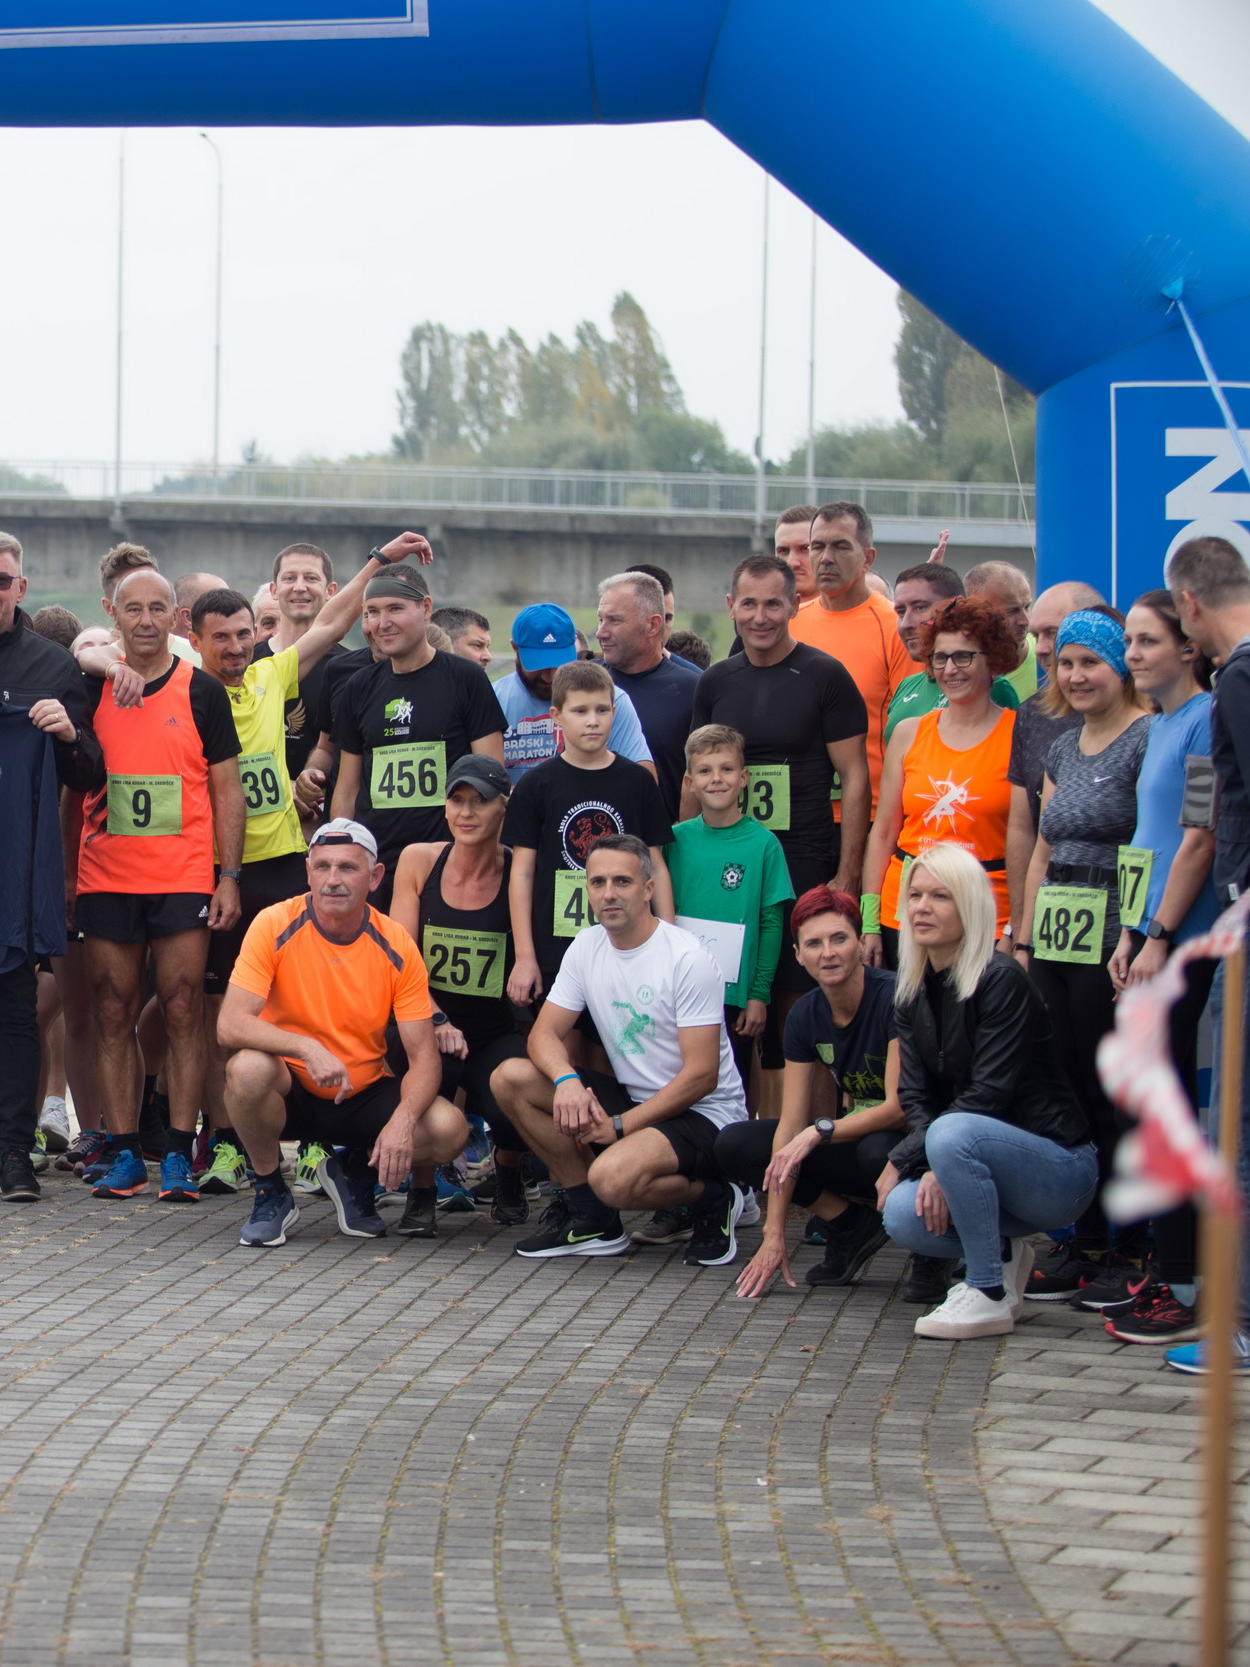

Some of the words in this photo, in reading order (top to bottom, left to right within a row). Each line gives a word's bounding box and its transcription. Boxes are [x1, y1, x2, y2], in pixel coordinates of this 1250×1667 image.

[504, 737, 544, 750] BRDSKI
[504, 748, 553, 761] MARATON
[378, 758, 438, 799] 456
[132, 789, 151, 828] 9
[1039, 907, 1095, 953] 482
[430, 944, 497, 989] 257
